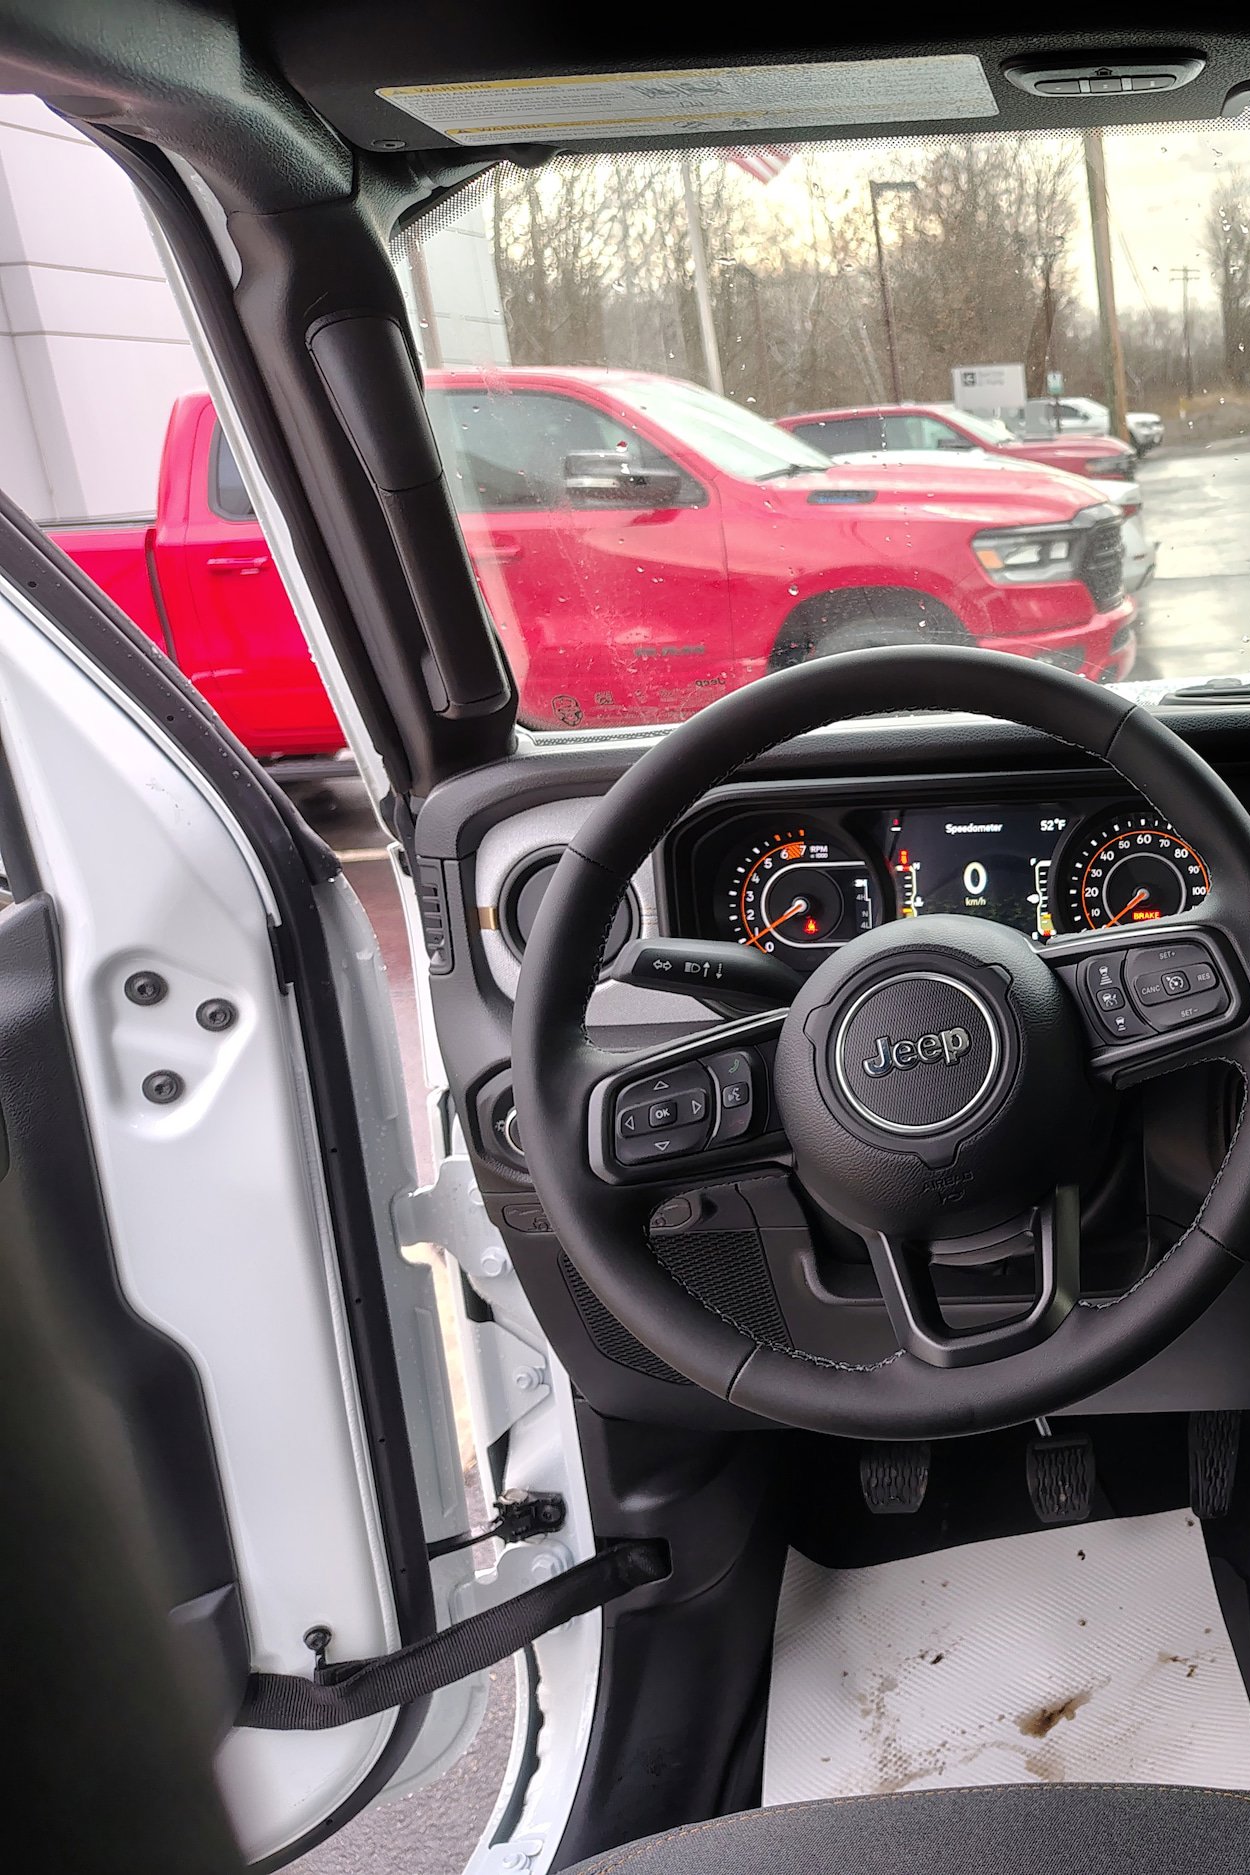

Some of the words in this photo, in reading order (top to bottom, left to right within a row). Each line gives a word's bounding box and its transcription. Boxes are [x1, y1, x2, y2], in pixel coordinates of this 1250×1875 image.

[945, 822, 1003, 835] Speedometer
[1118, 840, 1131, 849] 50
[1136, 834, 1152, 844] 60
[1158, 839, 1171, 848] 70
[780, 848, 789, 859] 6
[809, 845, 829, 853] RPM
[1174, 848, 1189, 859] 80
[1100, 850, 1115, 861] 40
[763, 858, 773, 869] 5
[1090, 868, 1102, 878] 30
[1188, 865, 1200, 875] 90
[751, 872, 760, 884] 4
[963, 861, 987, 895] 0
[746, 890, 755, 902] 3
[1084, 887, 1099, 898] 20
[1192, 886, 1207, 896] 100
[965, 896, 987, 907] km/h
[746, 909, 755, 921] 2
[1091, 907, 1101, 917] 10
[1133, 911, 1161, 920] BRAKE
[764, 941, 775, 953] 0
[1197, 972, 1211, 981] RES
[1141, 984, 1161, 995] CANC
[863, 1026, 972, 1078] Jeep
[655, 1107, 671, 1119] OK
